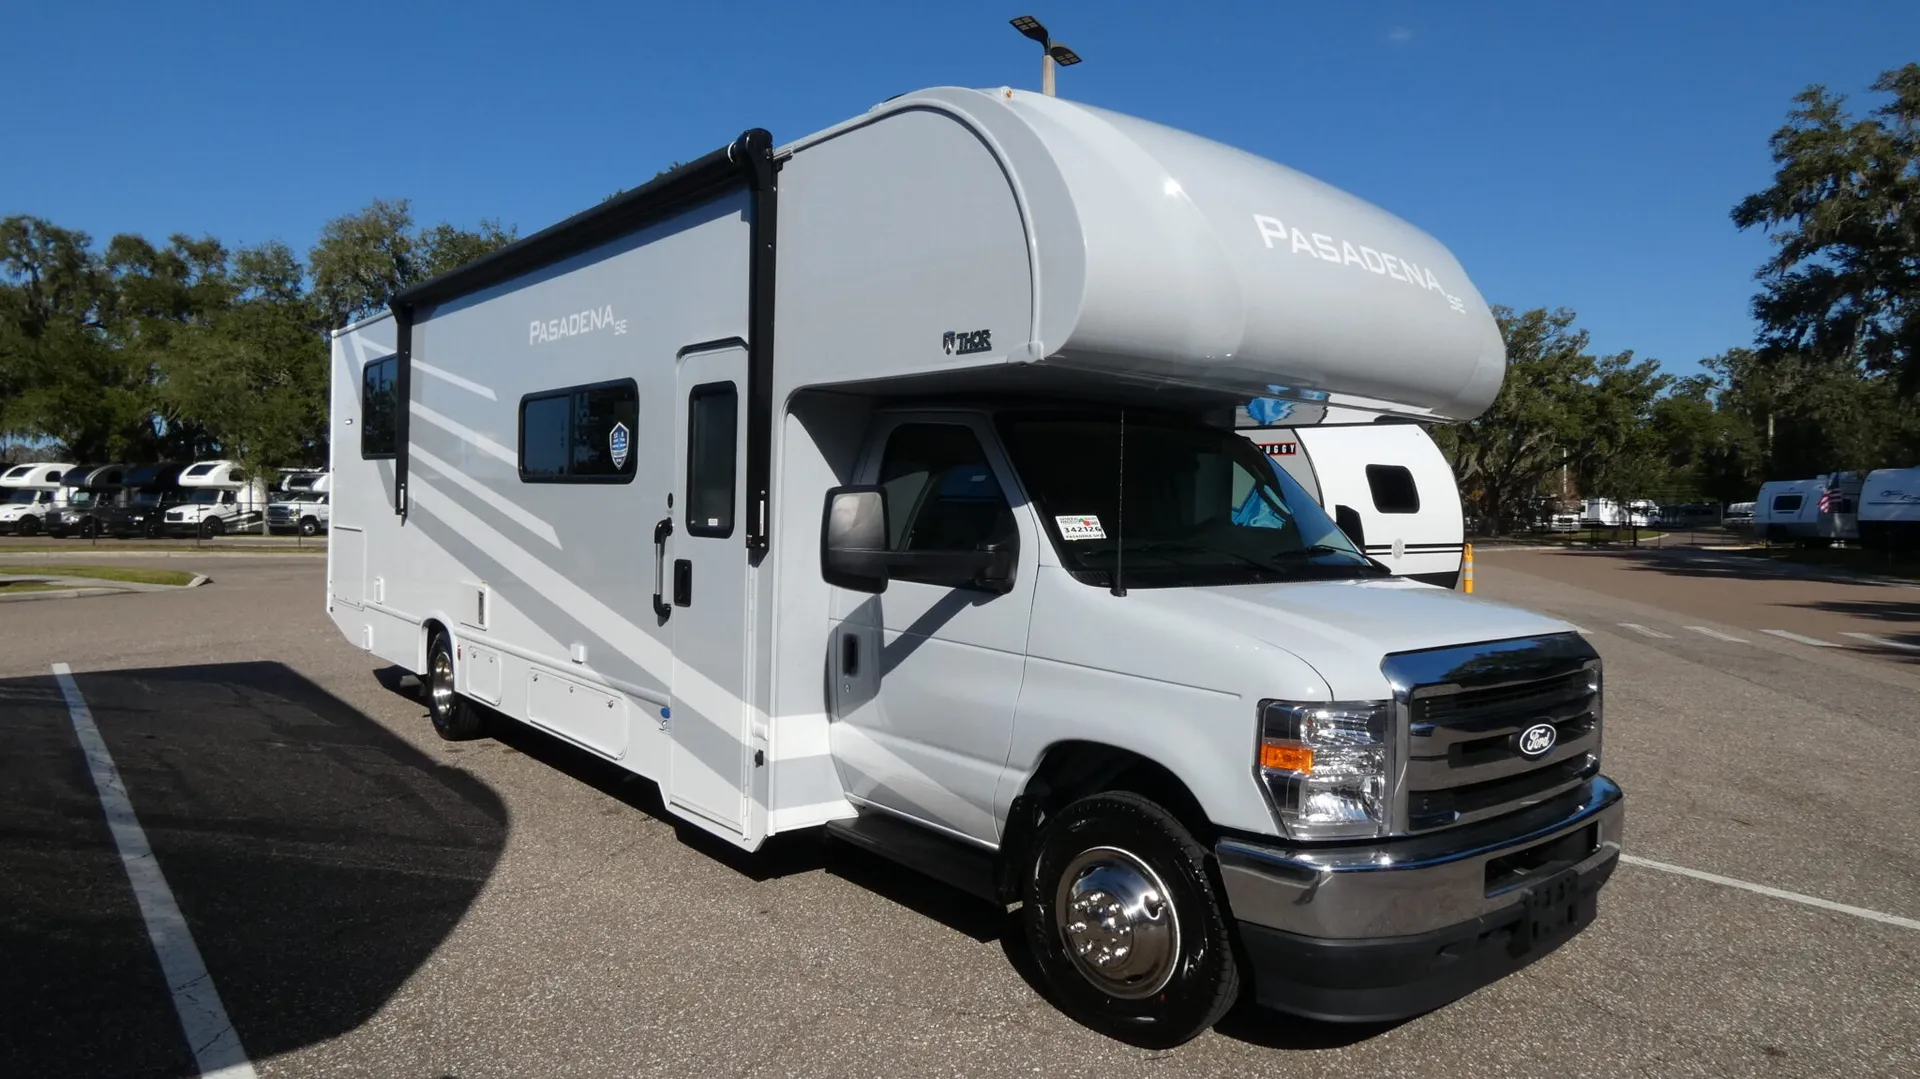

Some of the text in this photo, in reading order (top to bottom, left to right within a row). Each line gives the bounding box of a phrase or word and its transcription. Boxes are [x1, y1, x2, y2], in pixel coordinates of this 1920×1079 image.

[1253, 213, 1466, 314] PASADENA SE
[529, 304, 628, 346] PASADENA SE
[956, 329, 992, 352] THOR
[1258, 444, 1296, 455] UGGY
[1527, 728, 1550, 750] Ford
